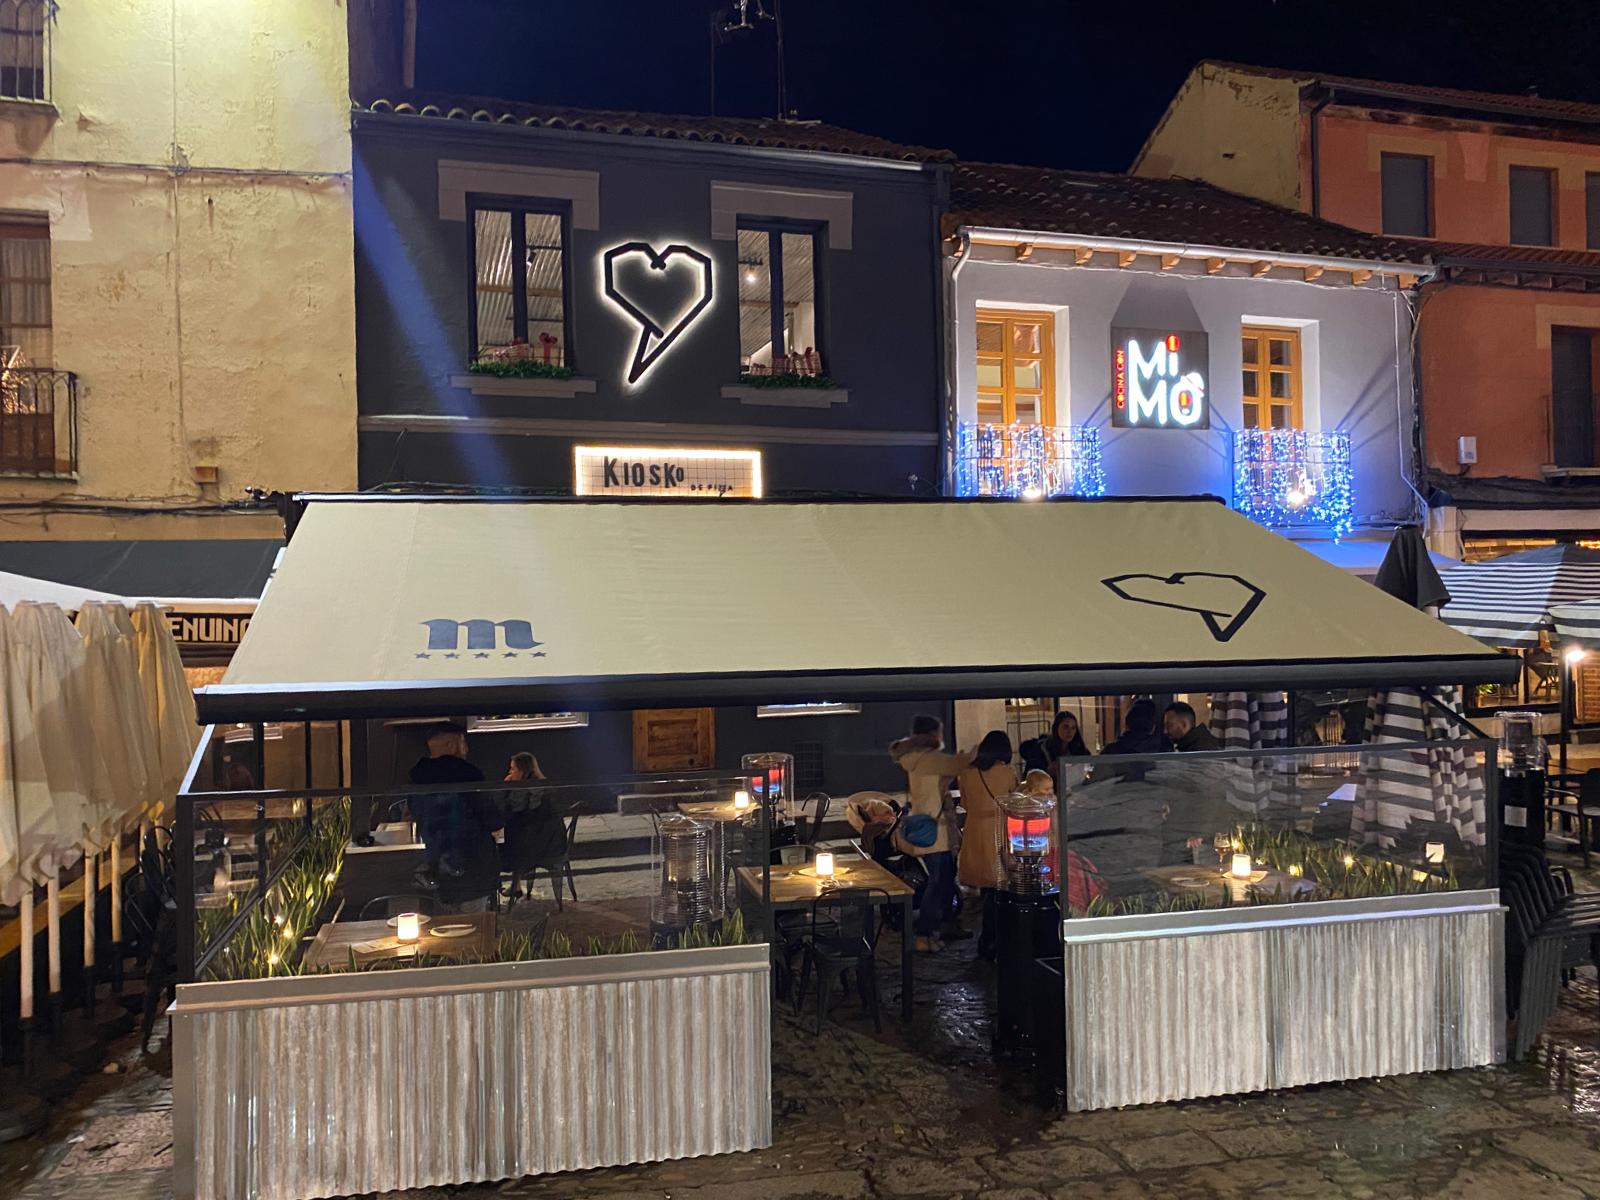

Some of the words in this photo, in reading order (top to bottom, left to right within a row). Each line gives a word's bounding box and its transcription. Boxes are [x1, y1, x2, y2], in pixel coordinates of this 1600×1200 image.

[1116, 350, 1124, 370] CON
[1116, 372, 1124, 408] COCINA
[604, 456, 684, 488] KIOSKO
